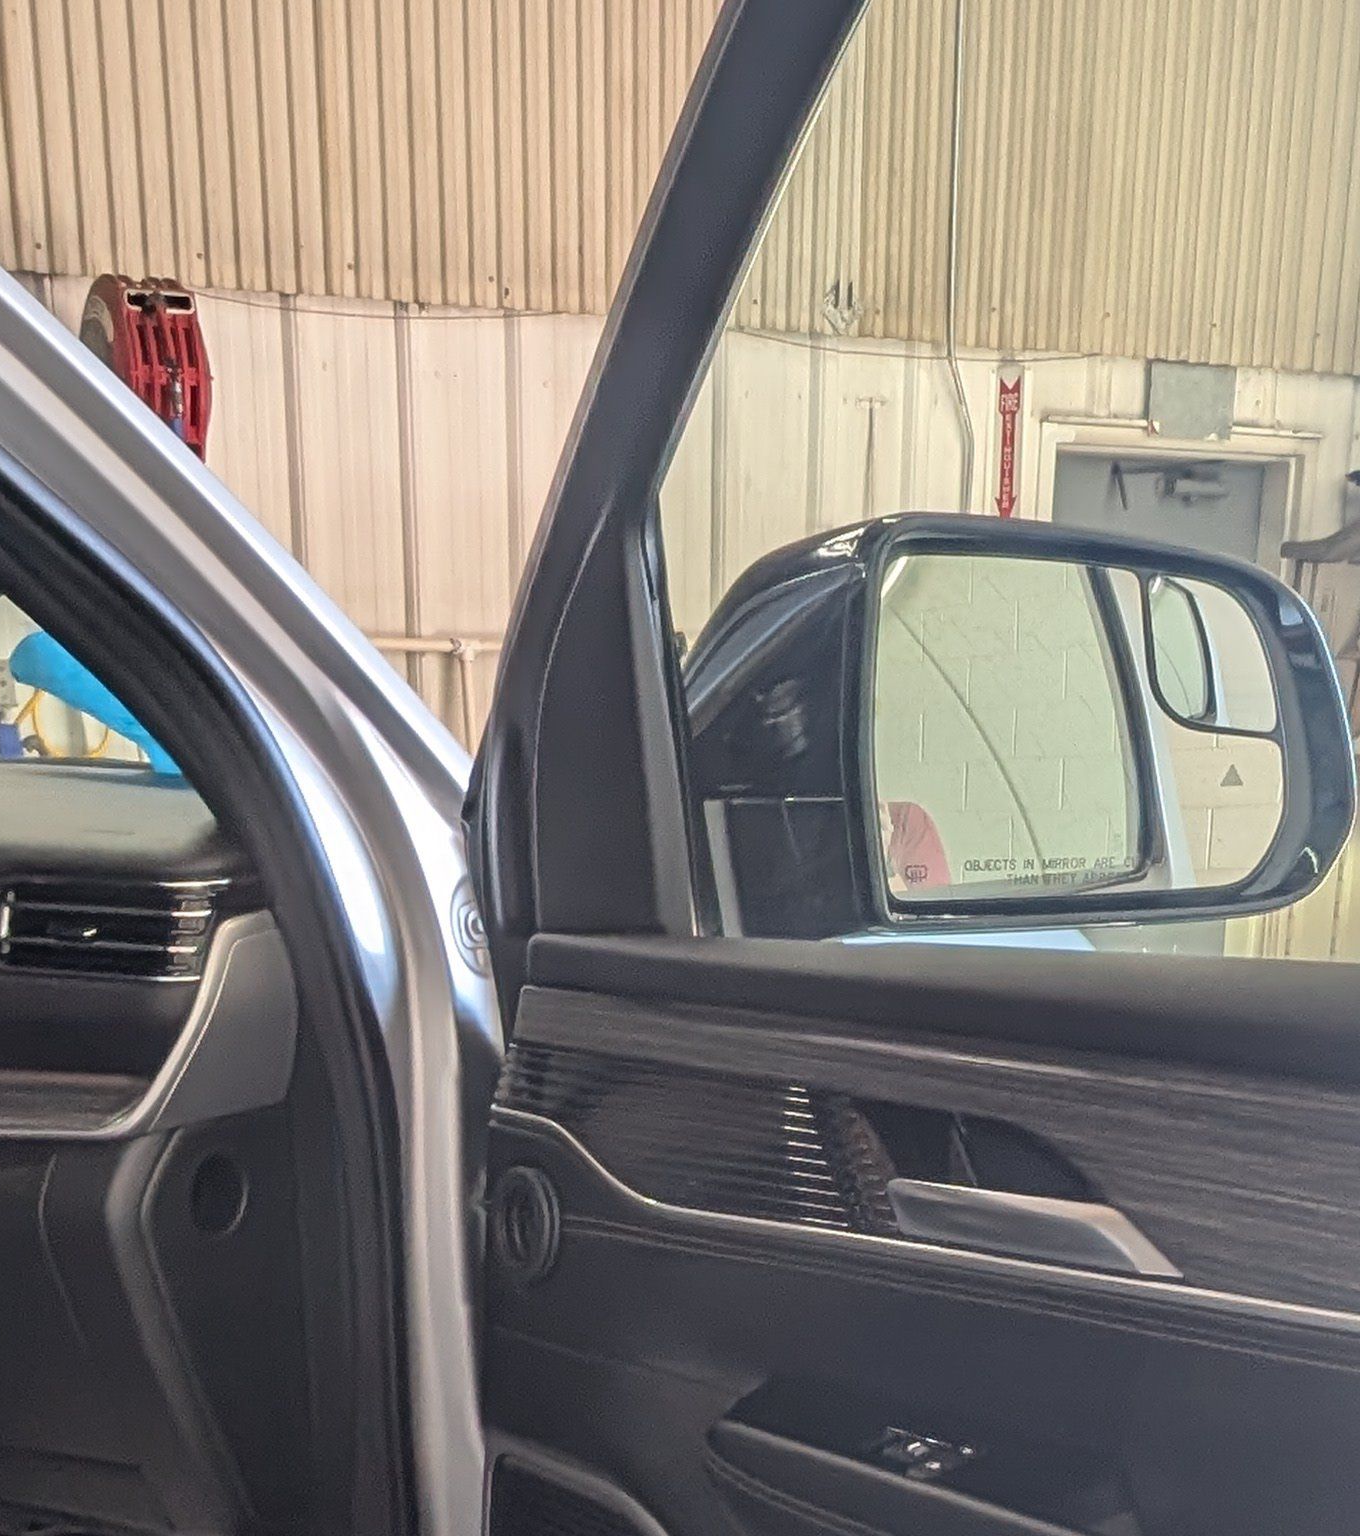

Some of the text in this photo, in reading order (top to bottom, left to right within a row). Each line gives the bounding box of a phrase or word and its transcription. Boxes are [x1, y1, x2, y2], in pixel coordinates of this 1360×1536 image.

[964, 858, 1017, 872] OBJECTS
[1023, 858, 1035, 870] IN
[1042, 858, 1087, 870] MIRROR
[1093, 856, 1116, 869] ARE
[1007, 873, 1039, 885] THAN
[1043, 872, 1076, 885] THEY
